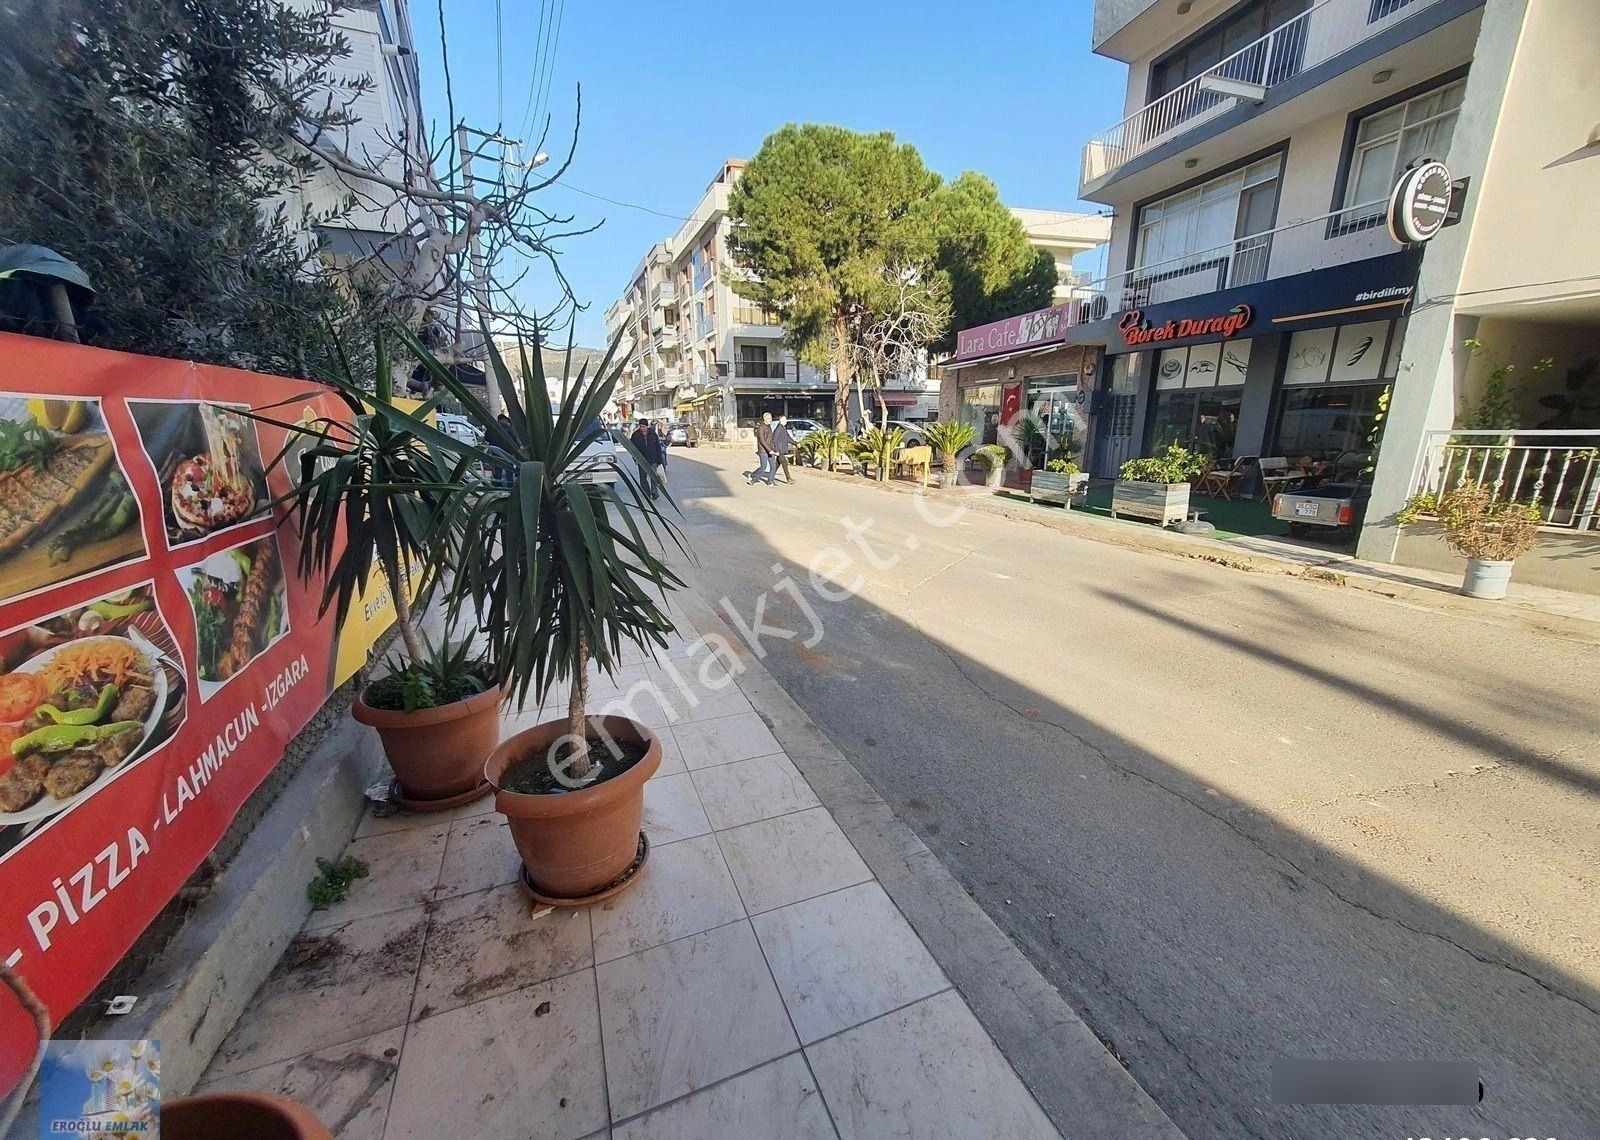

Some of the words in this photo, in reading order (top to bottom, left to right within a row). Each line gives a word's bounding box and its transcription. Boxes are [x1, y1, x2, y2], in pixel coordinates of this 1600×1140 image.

[960, 334, 985, 355] Lara
[988, 320, 1017, 349] Cafe
[27, 826, 150, 952] PİZZA
[162, 702, 260, 825] LAHMACUN
